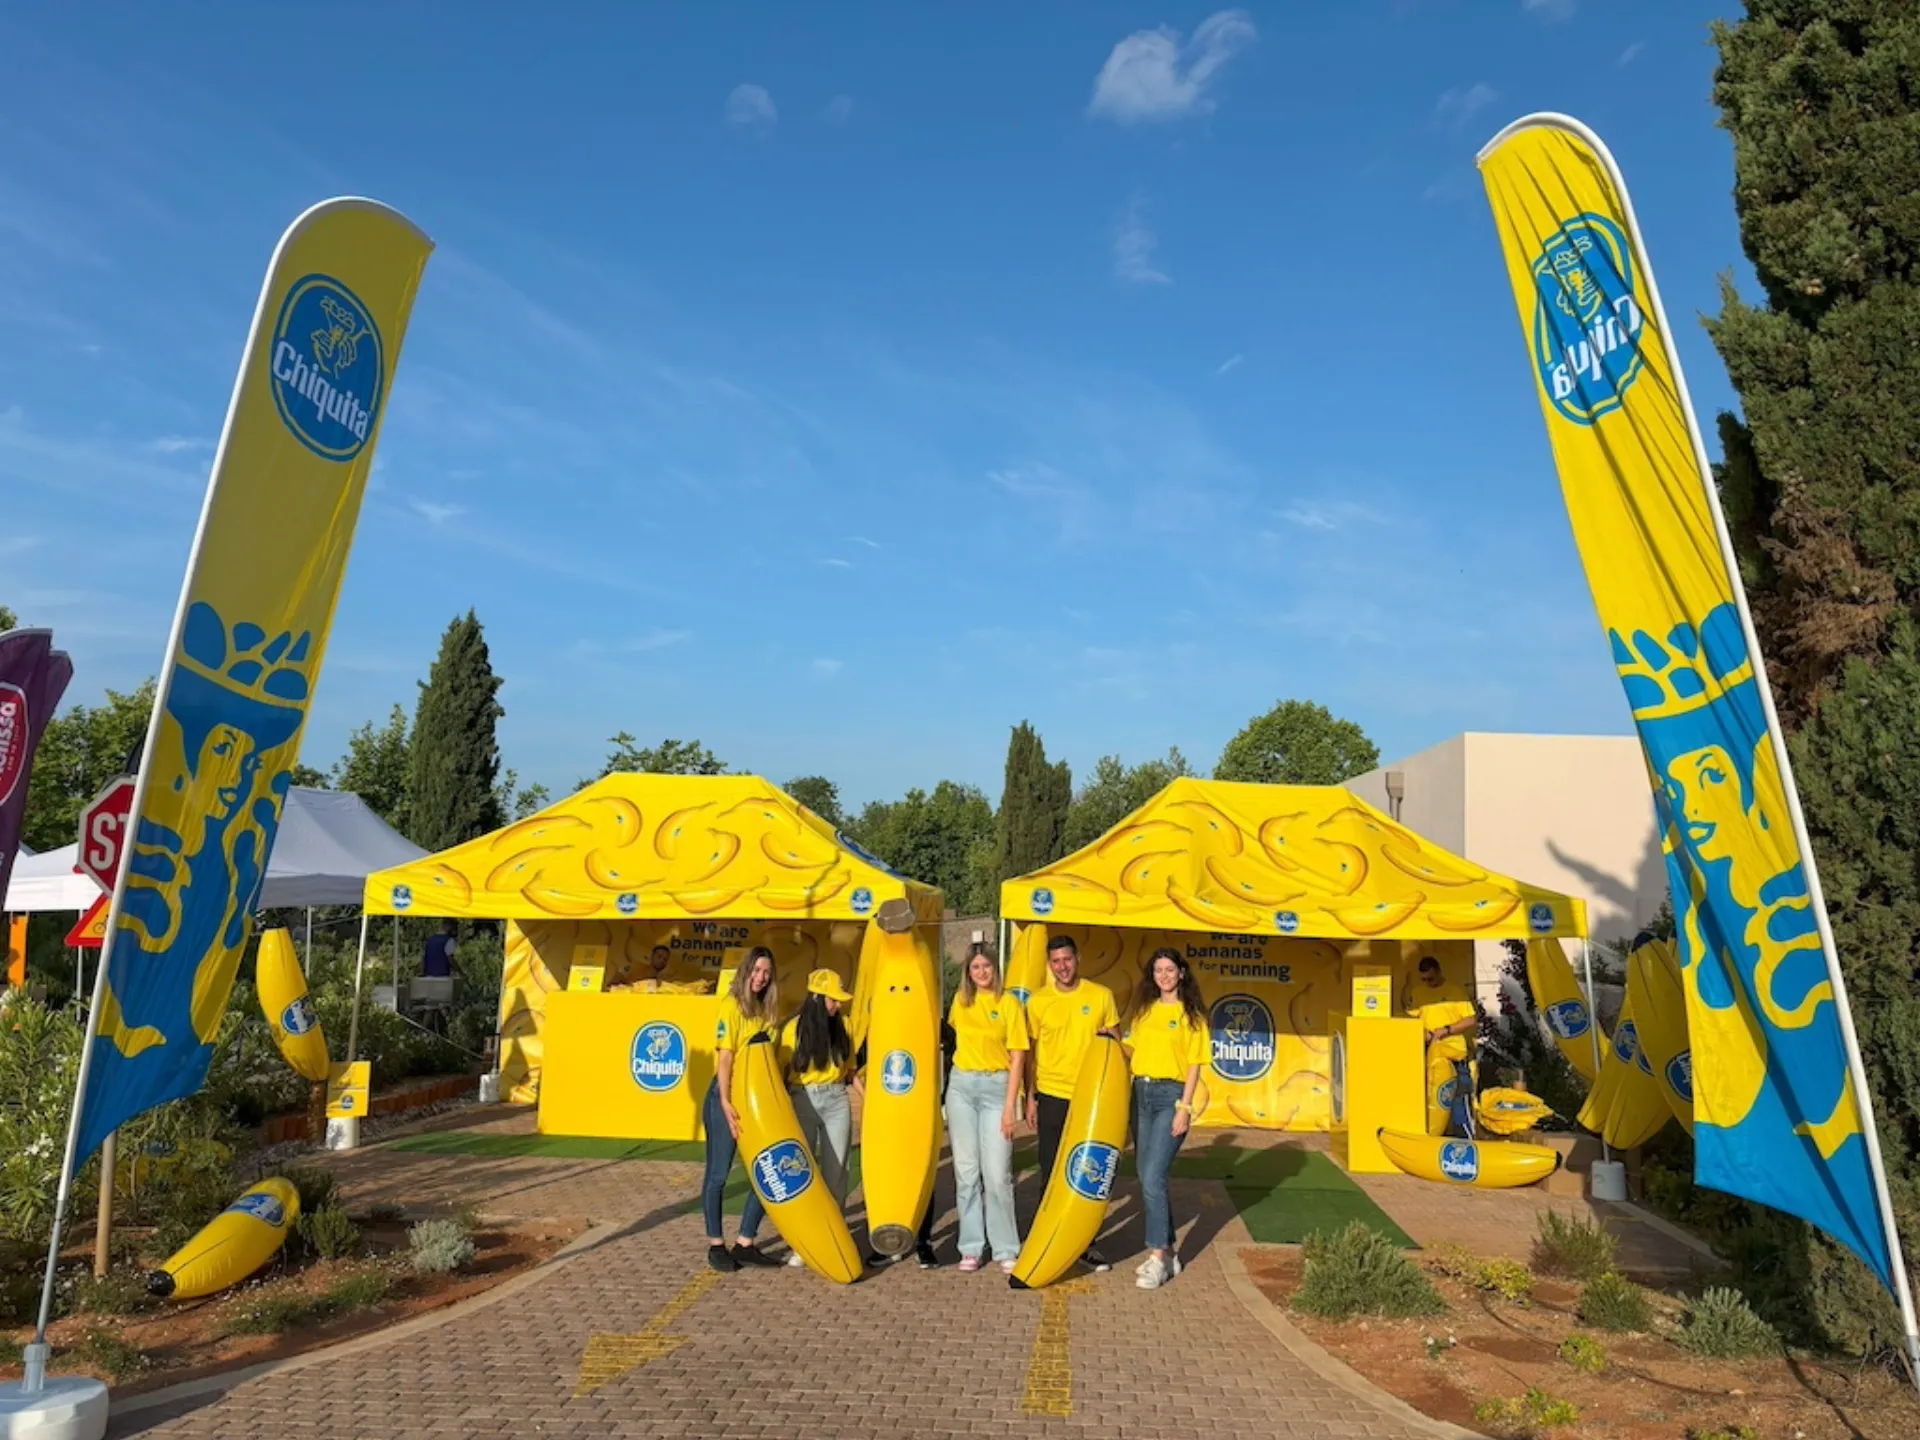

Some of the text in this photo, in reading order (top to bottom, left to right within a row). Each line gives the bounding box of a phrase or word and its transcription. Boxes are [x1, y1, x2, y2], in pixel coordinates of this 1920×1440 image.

[273, 340, 370, 442] Chiquita
[90, 812, 130, 871] ST
[720, 926, 749, 938] are
[1187, 943, 1263, 959] bananas
[1220, 961, 1290, 982] running
[1211, 1040, 1272, 1067] Chiquita
[633, 1057, 684, 1080] Chiquita
